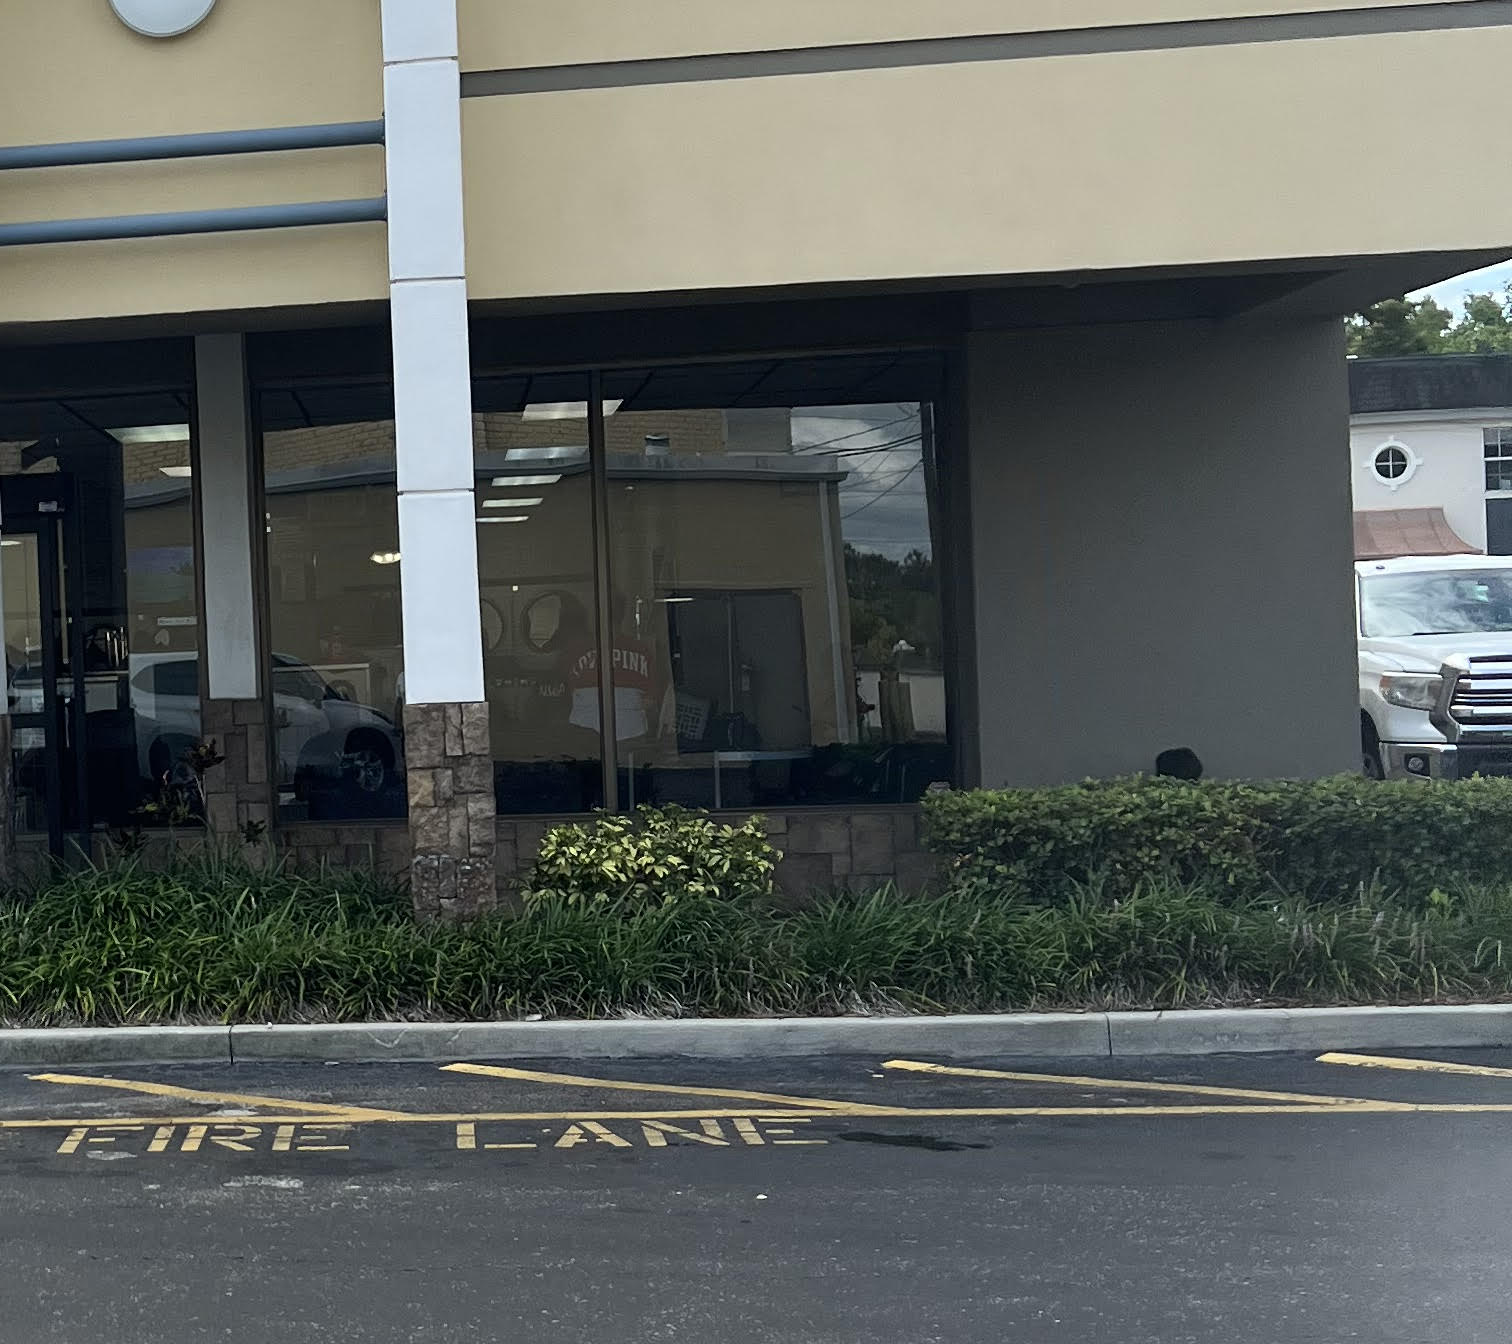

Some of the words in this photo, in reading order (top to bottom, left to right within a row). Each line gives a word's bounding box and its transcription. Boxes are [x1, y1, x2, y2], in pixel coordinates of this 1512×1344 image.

[612, 648, 649, 678] PINK
[57, 1122, 351, 1154] FIRE
[455, 1117, 829, 1150] LANE
